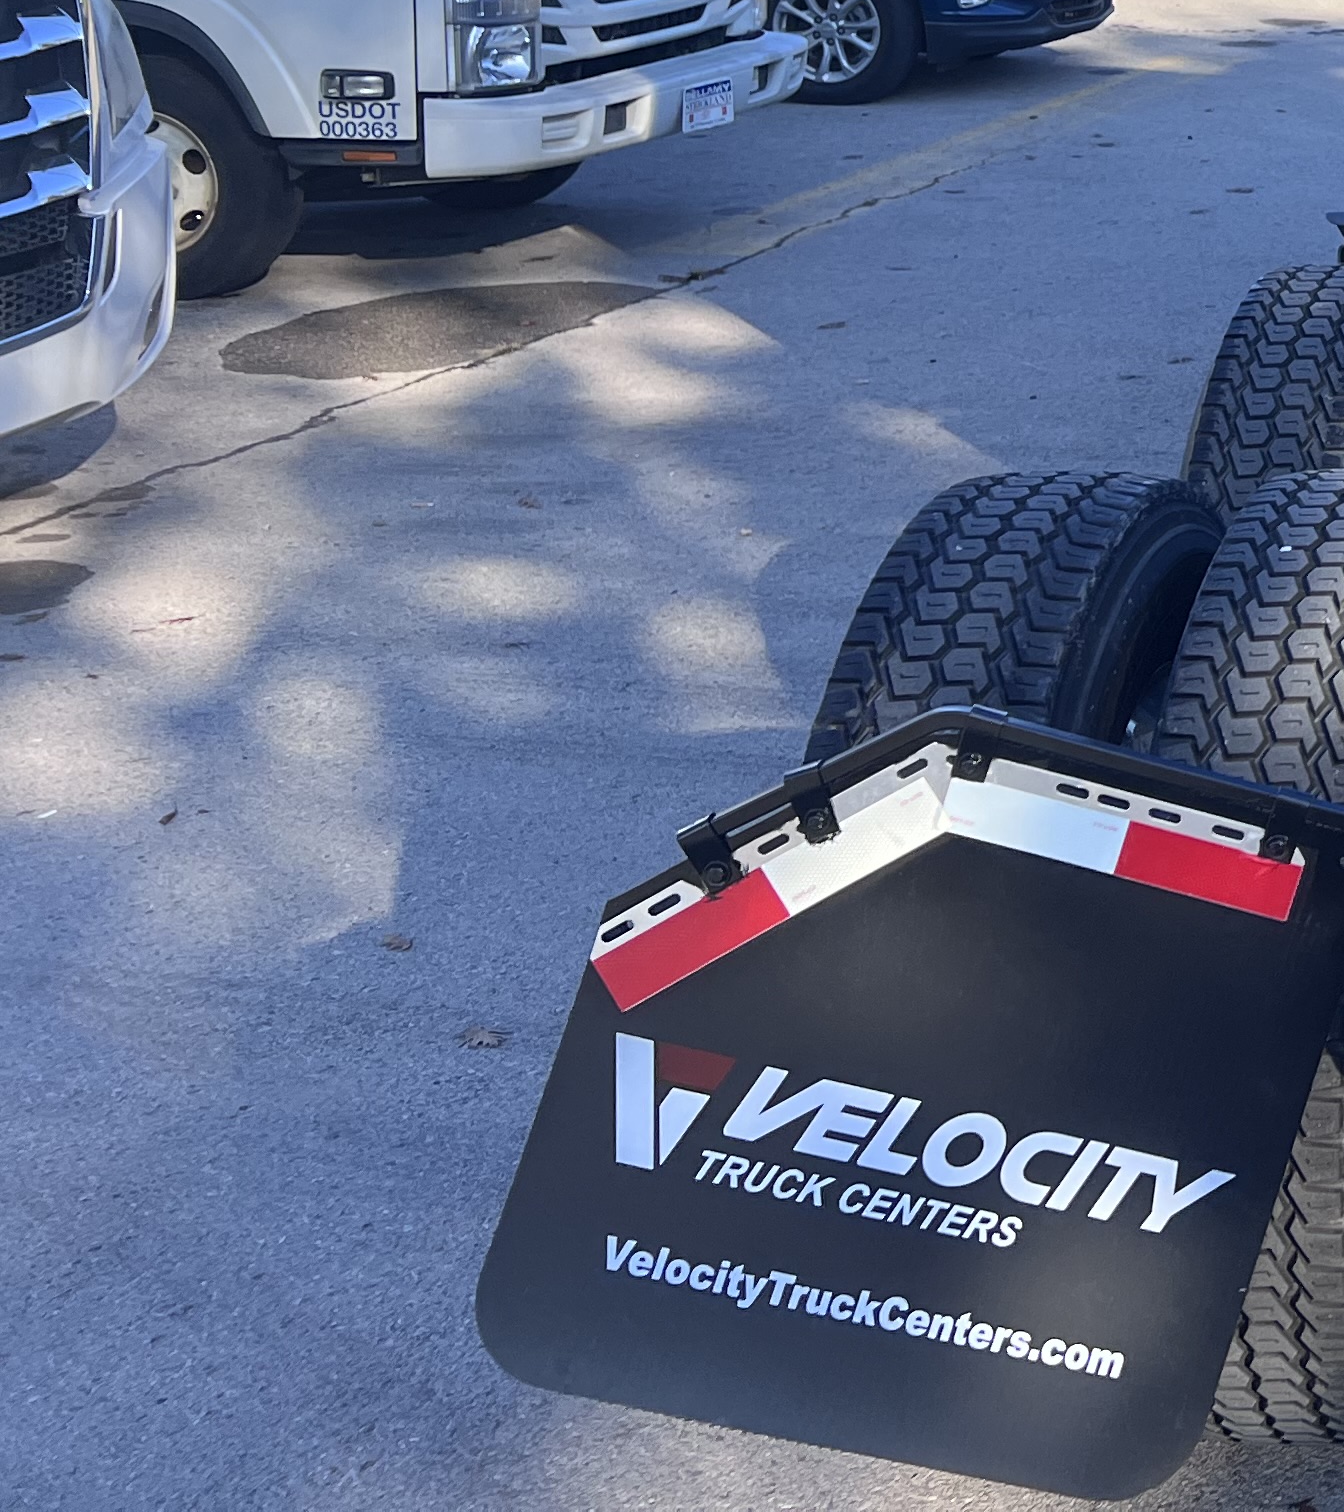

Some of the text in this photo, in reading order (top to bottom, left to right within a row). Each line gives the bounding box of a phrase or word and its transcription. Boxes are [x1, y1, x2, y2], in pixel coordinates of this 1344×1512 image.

[318, 101, 401, 120] USDOT
[319, 120, 398, 139] 000363
[694, 1149, 1023, 1248] TRUCK CENTERS
[722, 1065, 1236, 1234] VELOCITY
[605, 1234, 1126, 1380] VelocityTruckCenters.com
